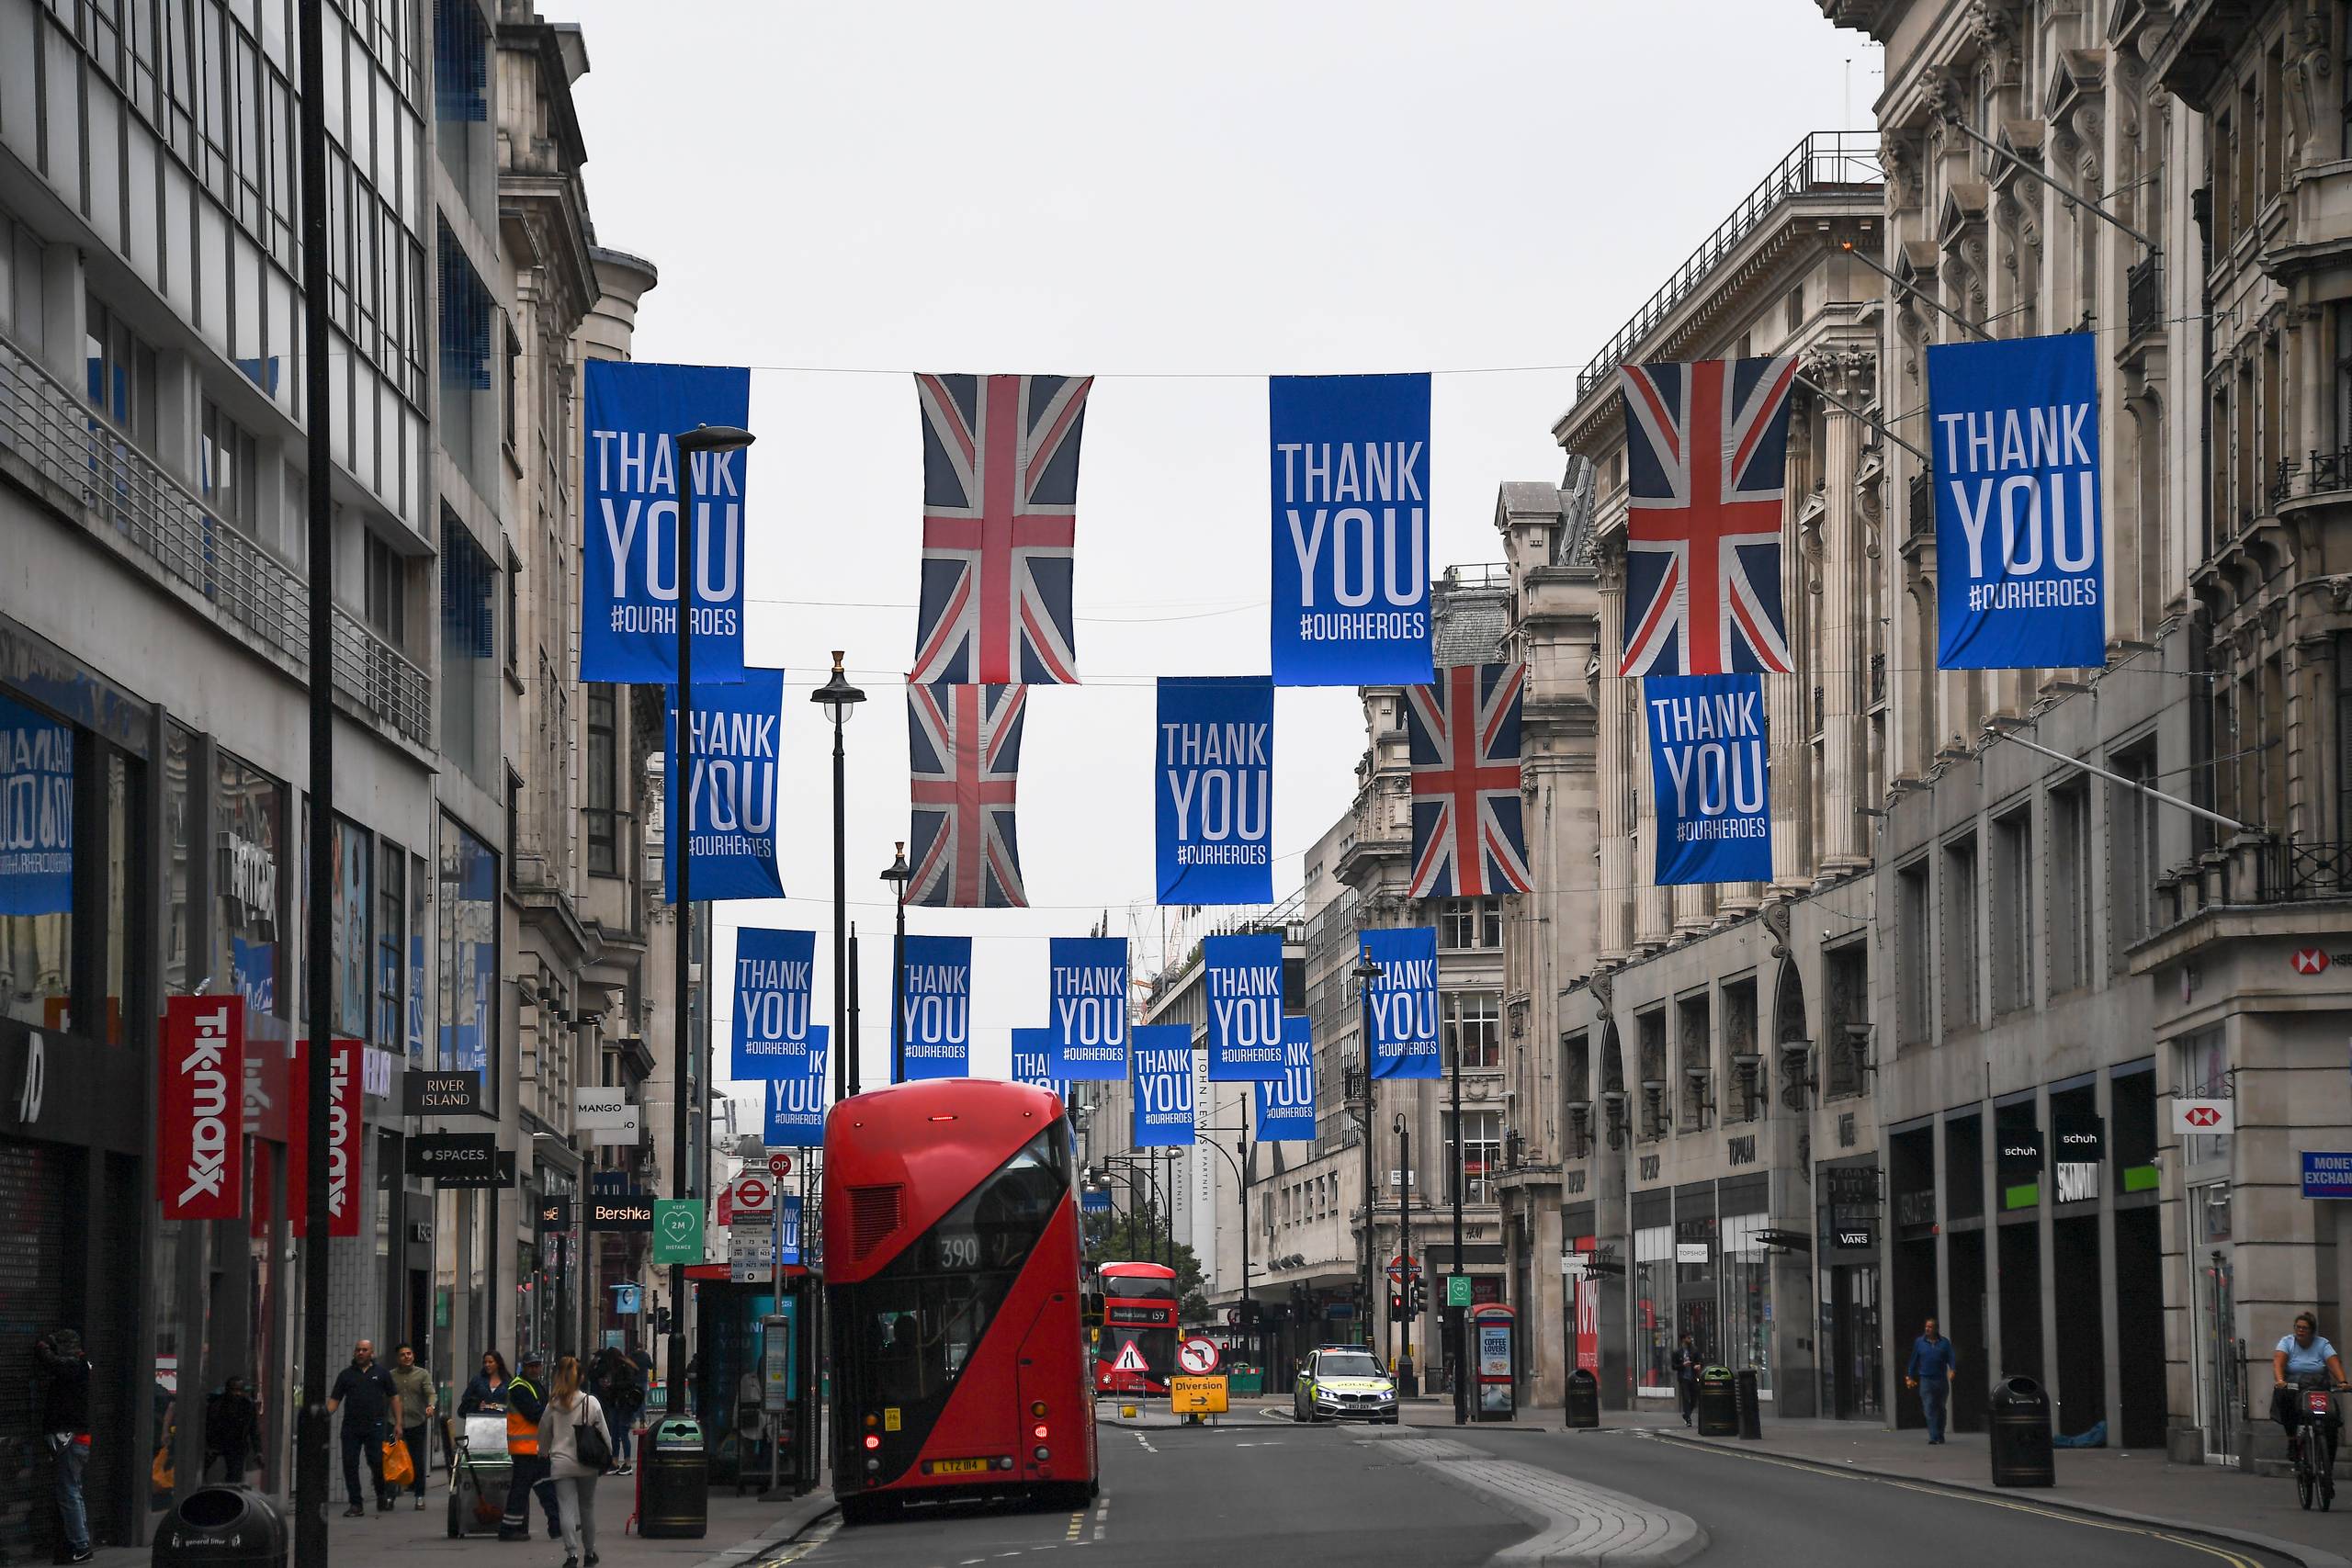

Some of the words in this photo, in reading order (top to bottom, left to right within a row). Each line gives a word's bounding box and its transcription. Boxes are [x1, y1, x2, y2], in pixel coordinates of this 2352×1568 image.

[1938, 403, 2091, 474] THANK
[593, 430, 738, 497] THANK
[1278, 442, 1424, 503] THANK
[1951, 470, 2096, 579] YOU
[600, 499, 738, 602] YOU
[1287, 508, 1423, 607] YOU
[1968, 578, 2097, 613] #OURHEROES
[611, 605, 736, 636] #OURHROES
[1300, 613, 1425, 641] #OURHEROES
[1652, 691, 1758, 743] THANK
[1162, 723, 1268, 765] THANK
[1663, 740, 1765, 818] YOU
[1167, 769, 1268, 841] YOU
[1677, 818, 1766, 842] #OURHEROES
[1177, 844, 1266, 866] #OURHEROES
[739, 958, 809, 990] THANK
[904, 964, 967, 994] HANK
[1054, 967, 1123, 996] THANK
[1209, 966, 1279, 998] THANK
[1372, 960, 1433, 991] HANK
[741, 990, 808, 1040] YOU
[904, 995, 966, 1043] YOU
[1057, 998, 1124, 1045] YOU
[1214, 998, 1282, 1046] YOU
[1370, 990, 1436, 1041] YOU
[745, 1041, 807, 1055] #OURHEROES
[905, 1044, 966, 1058] #OURHEROES
[1063, 1047, 1124, 1061] #OURHEROES
[1135, 1049, 1190, 1073] THANK
[1221, 1047, 1282, 1063] #OURHEROES
[1378, 1042, 1437, 1057] #OURHEROES
[427, 1079, 464, 1092] RIVER
[1198, 1058, 1207, 1095] JOHN
[422, 1094, 470, 1106] ISLAND
[1139, 1074, 1192, 1112] YOU
[578, 1104, 622, 1112] MANGO
[775, 1113, 822, 1125] #OURHEROES
[1145, 1113, 1193, 1125] #OURHEROES
[1266, 1107, 1313, 1119] #OURHEROES
[1198, 1101, 1208, 1145] LEWIS
[2005, 1146, 2037, 1156] schuh
[2063, 1134, 2098, 1144] schuh
[435, 1149, 488, 1161] SPACES.
[772, 1161, 788, 1170] OP
[595, 1206, 651, 1220] Bershka
[1465, 1226, 1484, 1239] H&M
[1839, 1234, 1868, 1244] VANS
[941, 1238, 977, 1268] 390
[1152, 1311, 1165, 1320] 159
[1176, 1382, 1223, 1391] Diversion
[943, 1461, 961, 1472] LTZ
